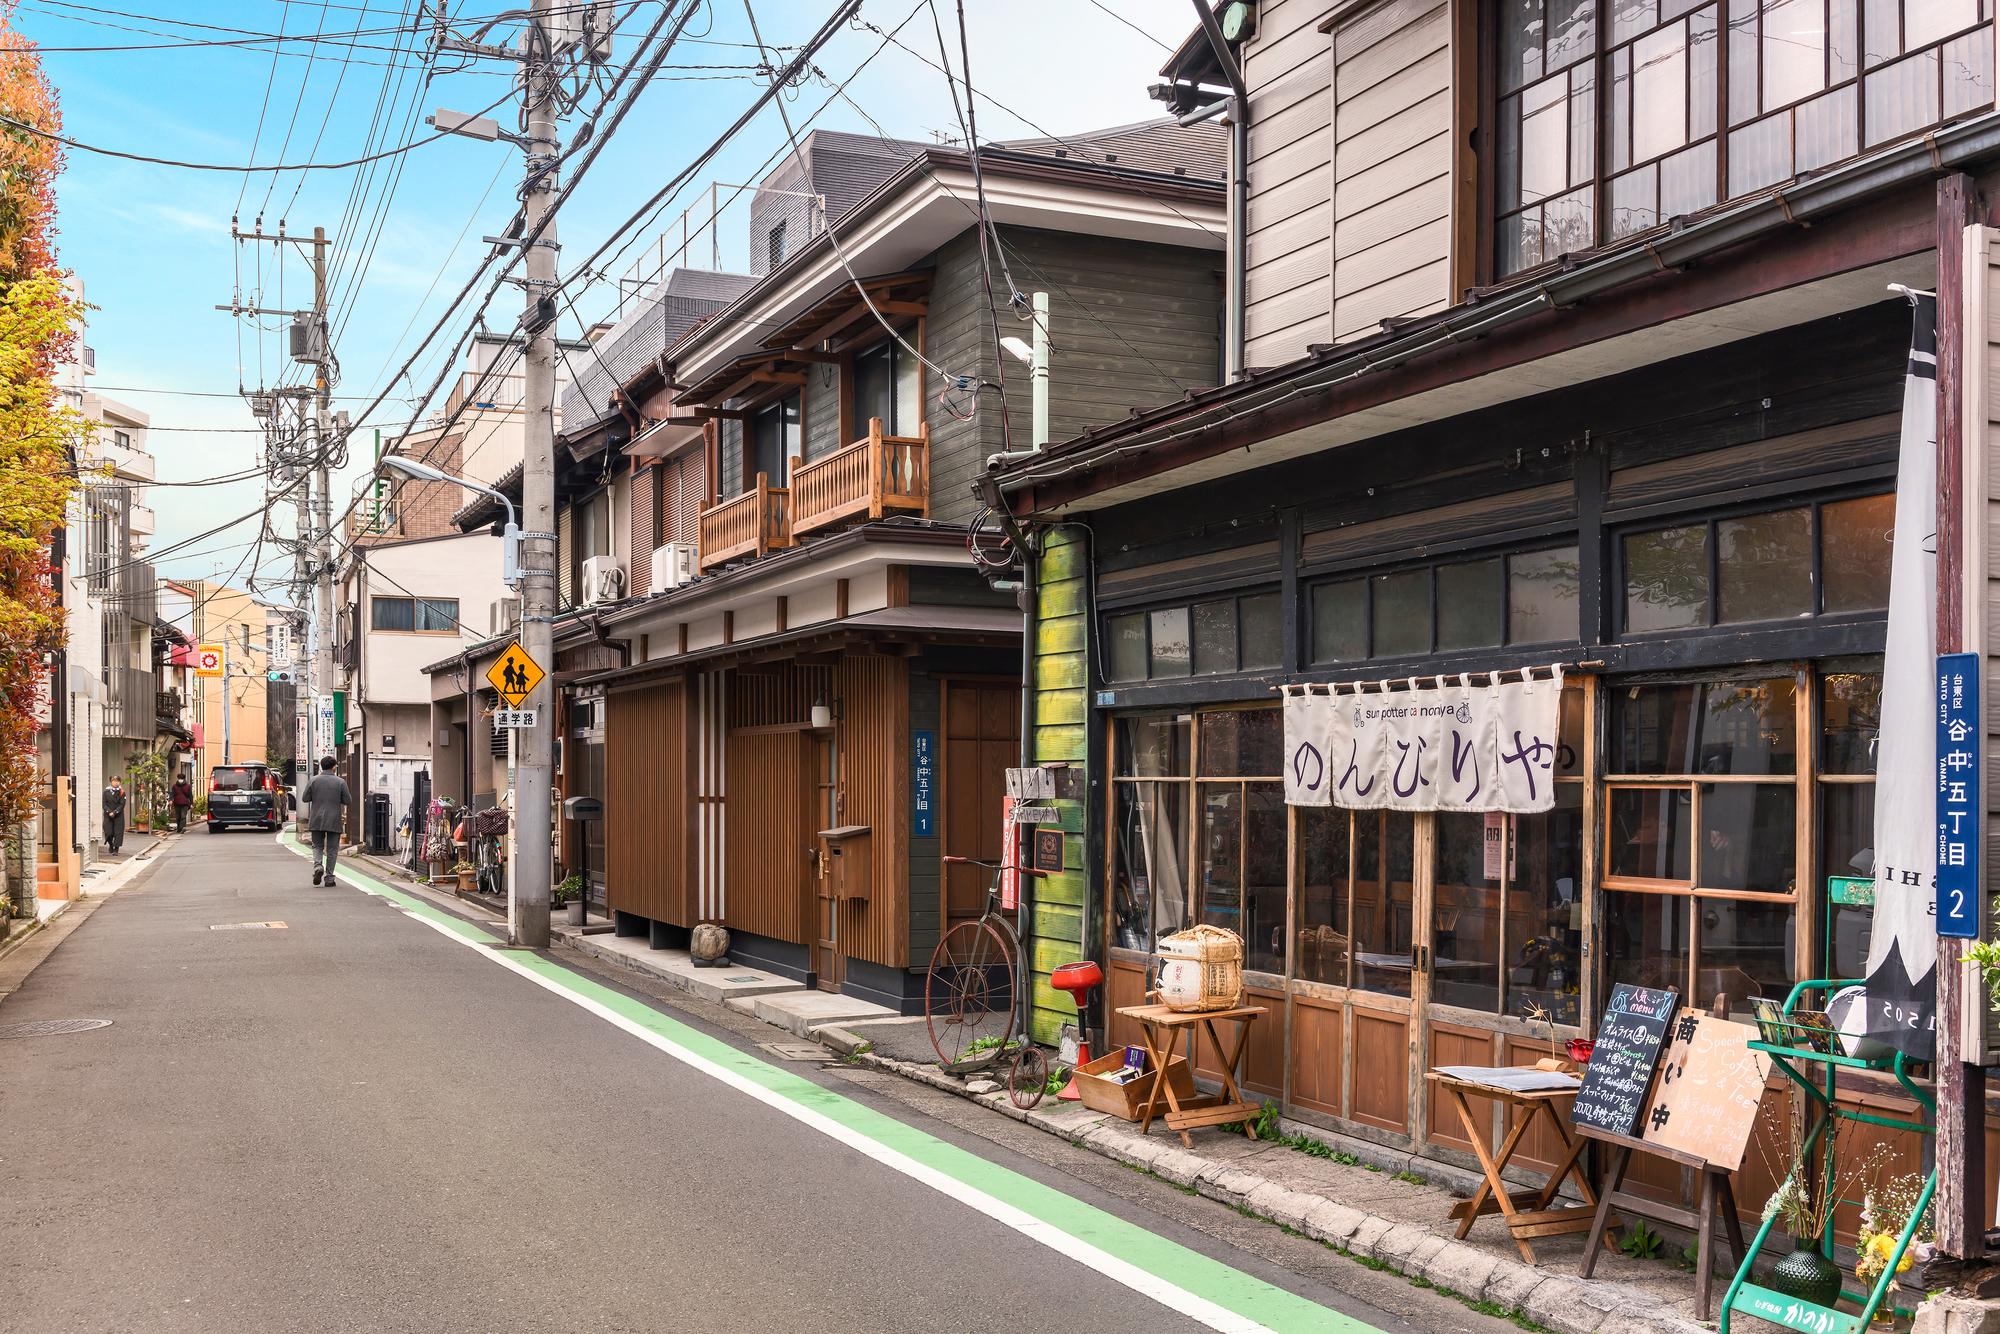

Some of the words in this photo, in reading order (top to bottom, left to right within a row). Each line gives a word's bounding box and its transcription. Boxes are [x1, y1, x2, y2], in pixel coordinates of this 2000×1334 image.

[1940, 675, 1948, 700] TAITO
[1953, 673, 1963, 709] 台東区
[498, 712, 533, 725] 通学路
[1381, 702, 1408, 720] potter
[1940, 704, 1948, 725] CITY
[1293, 729, 1554, 803] のんびりや
[1939, 757, 1947, 792] YANAKA
[920, 756, 928, 811] 谷中五丁目
[1948, 718, 1967, 866] 谷中五丁目
[921, 819, 926, 830] 1
[1939, 824, 1947, 865] 5-CHOME
[1949, 889, 1964, 918] 2
[1630, 1002, 1655, 1014] menu
[1651, 1015, 1700, 1132] 商い中
